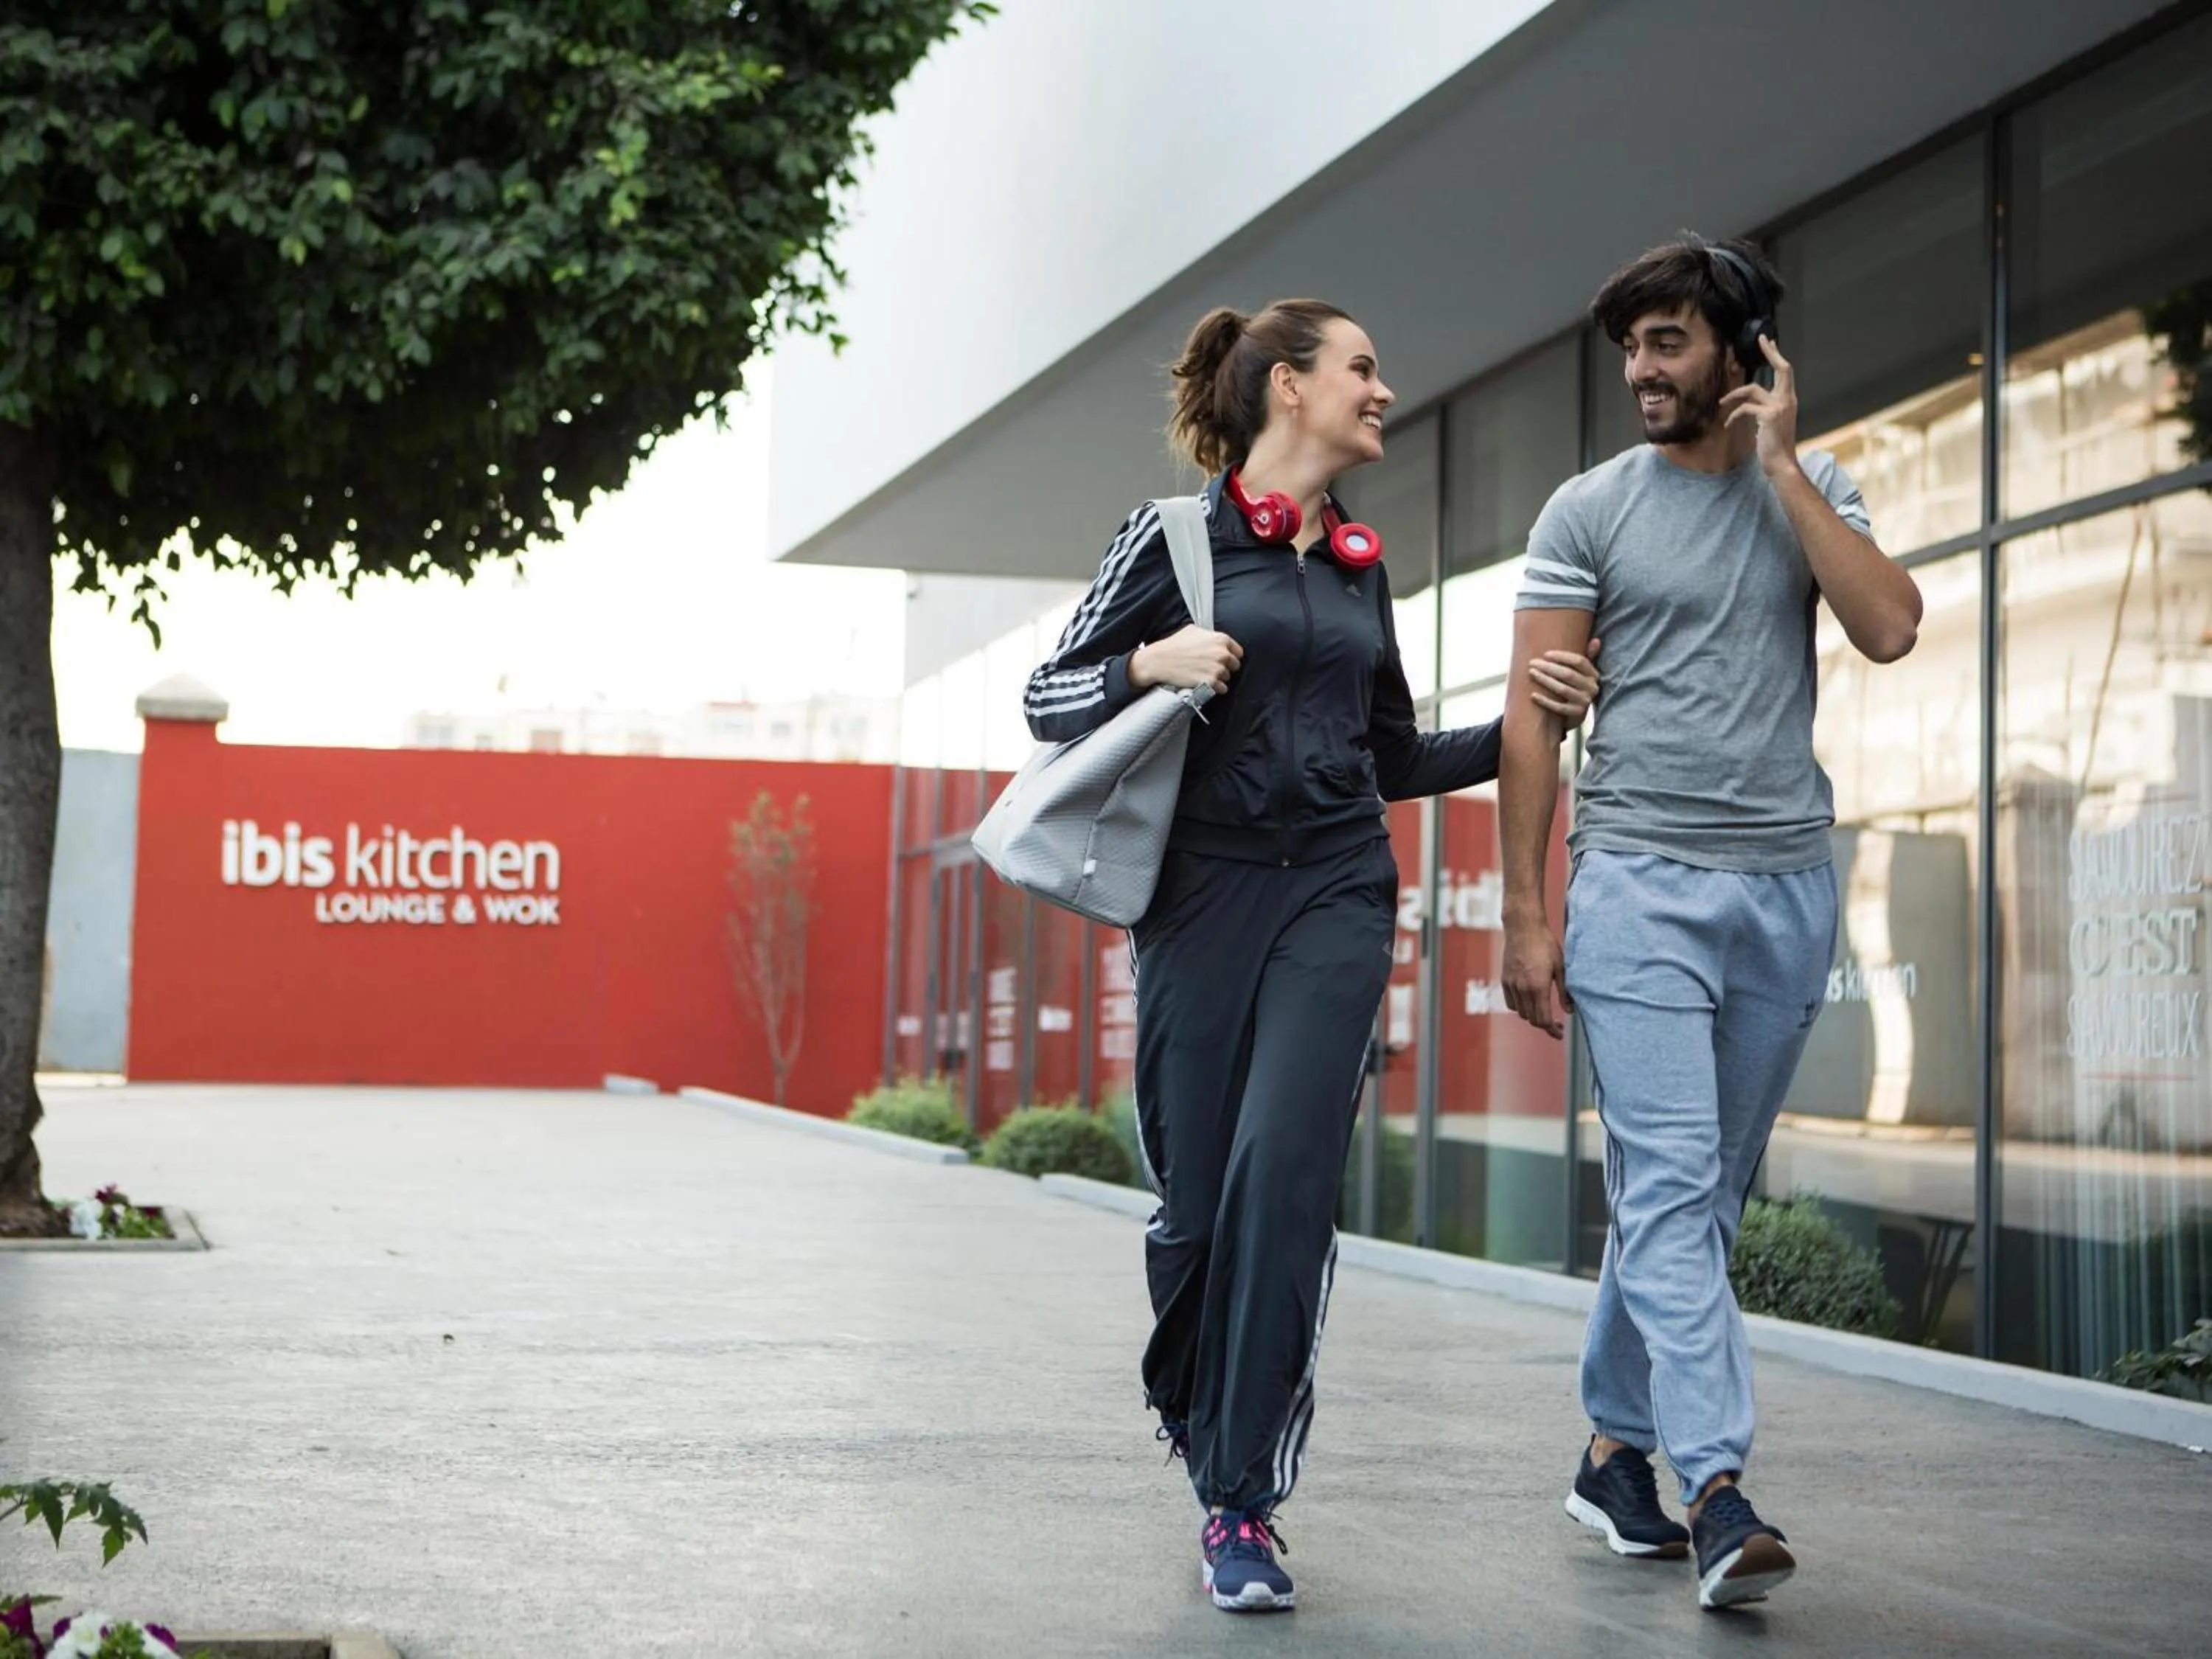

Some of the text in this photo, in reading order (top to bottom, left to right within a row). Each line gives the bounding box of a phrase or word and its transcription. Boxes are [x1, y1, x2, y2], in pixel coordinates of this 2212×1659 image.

[223, 818, 560, 890] ibis kitchen
[315, 891, 561, 925] LOUNGE & WOK
